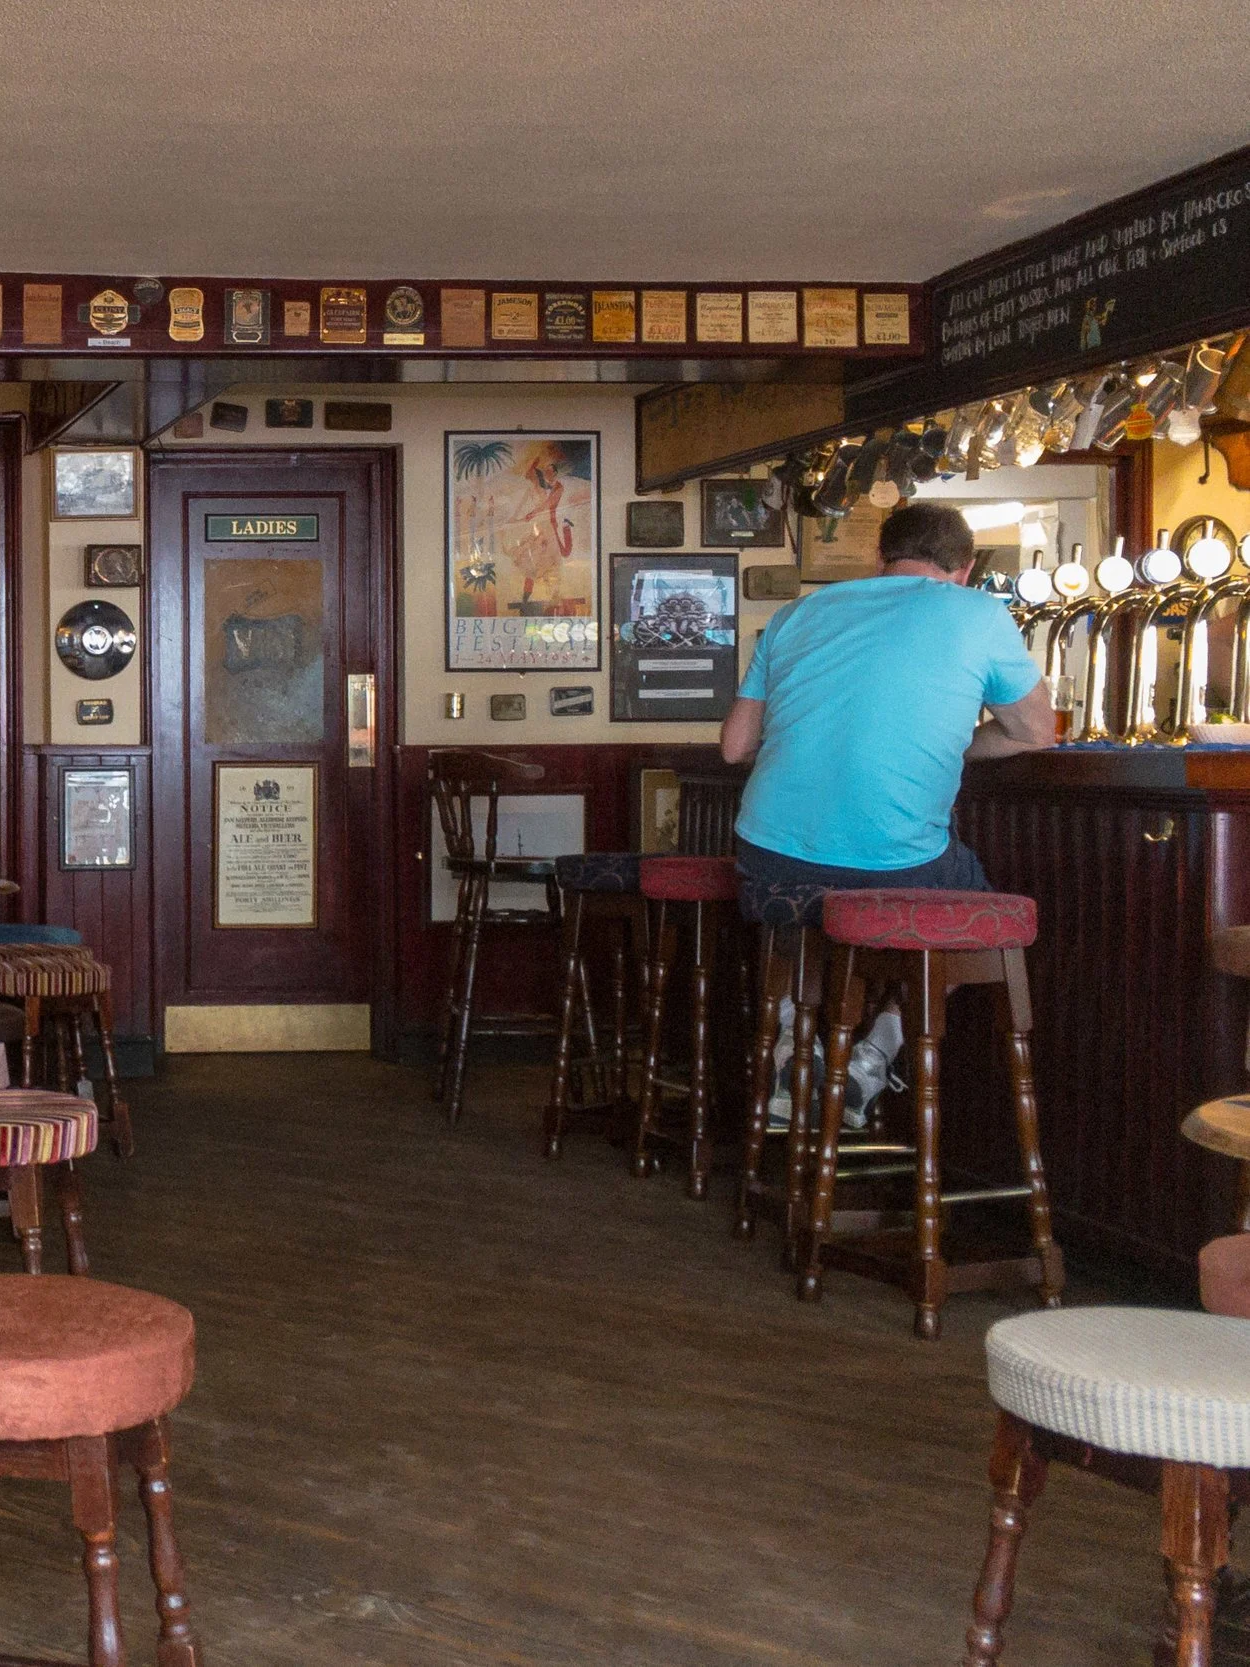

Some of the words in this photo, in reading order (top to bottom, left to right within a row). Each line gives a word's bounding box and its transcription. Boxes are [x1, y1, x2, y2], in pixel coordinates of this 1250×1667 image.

[1161, 208, 1178, 233] BY
[497, 297, 533, 307] JAMESON
[594, 301, 635, 314] DEANSTON
[554, 315, 576, 325] £1.00
[231, 520, 297, 535] LADIES
[240, 805, 292, 813] NOTICE
[230, 834, 253, 843] ALE
[256, 835, 269, 843] and
[272, 834, 302, 843] BEER
